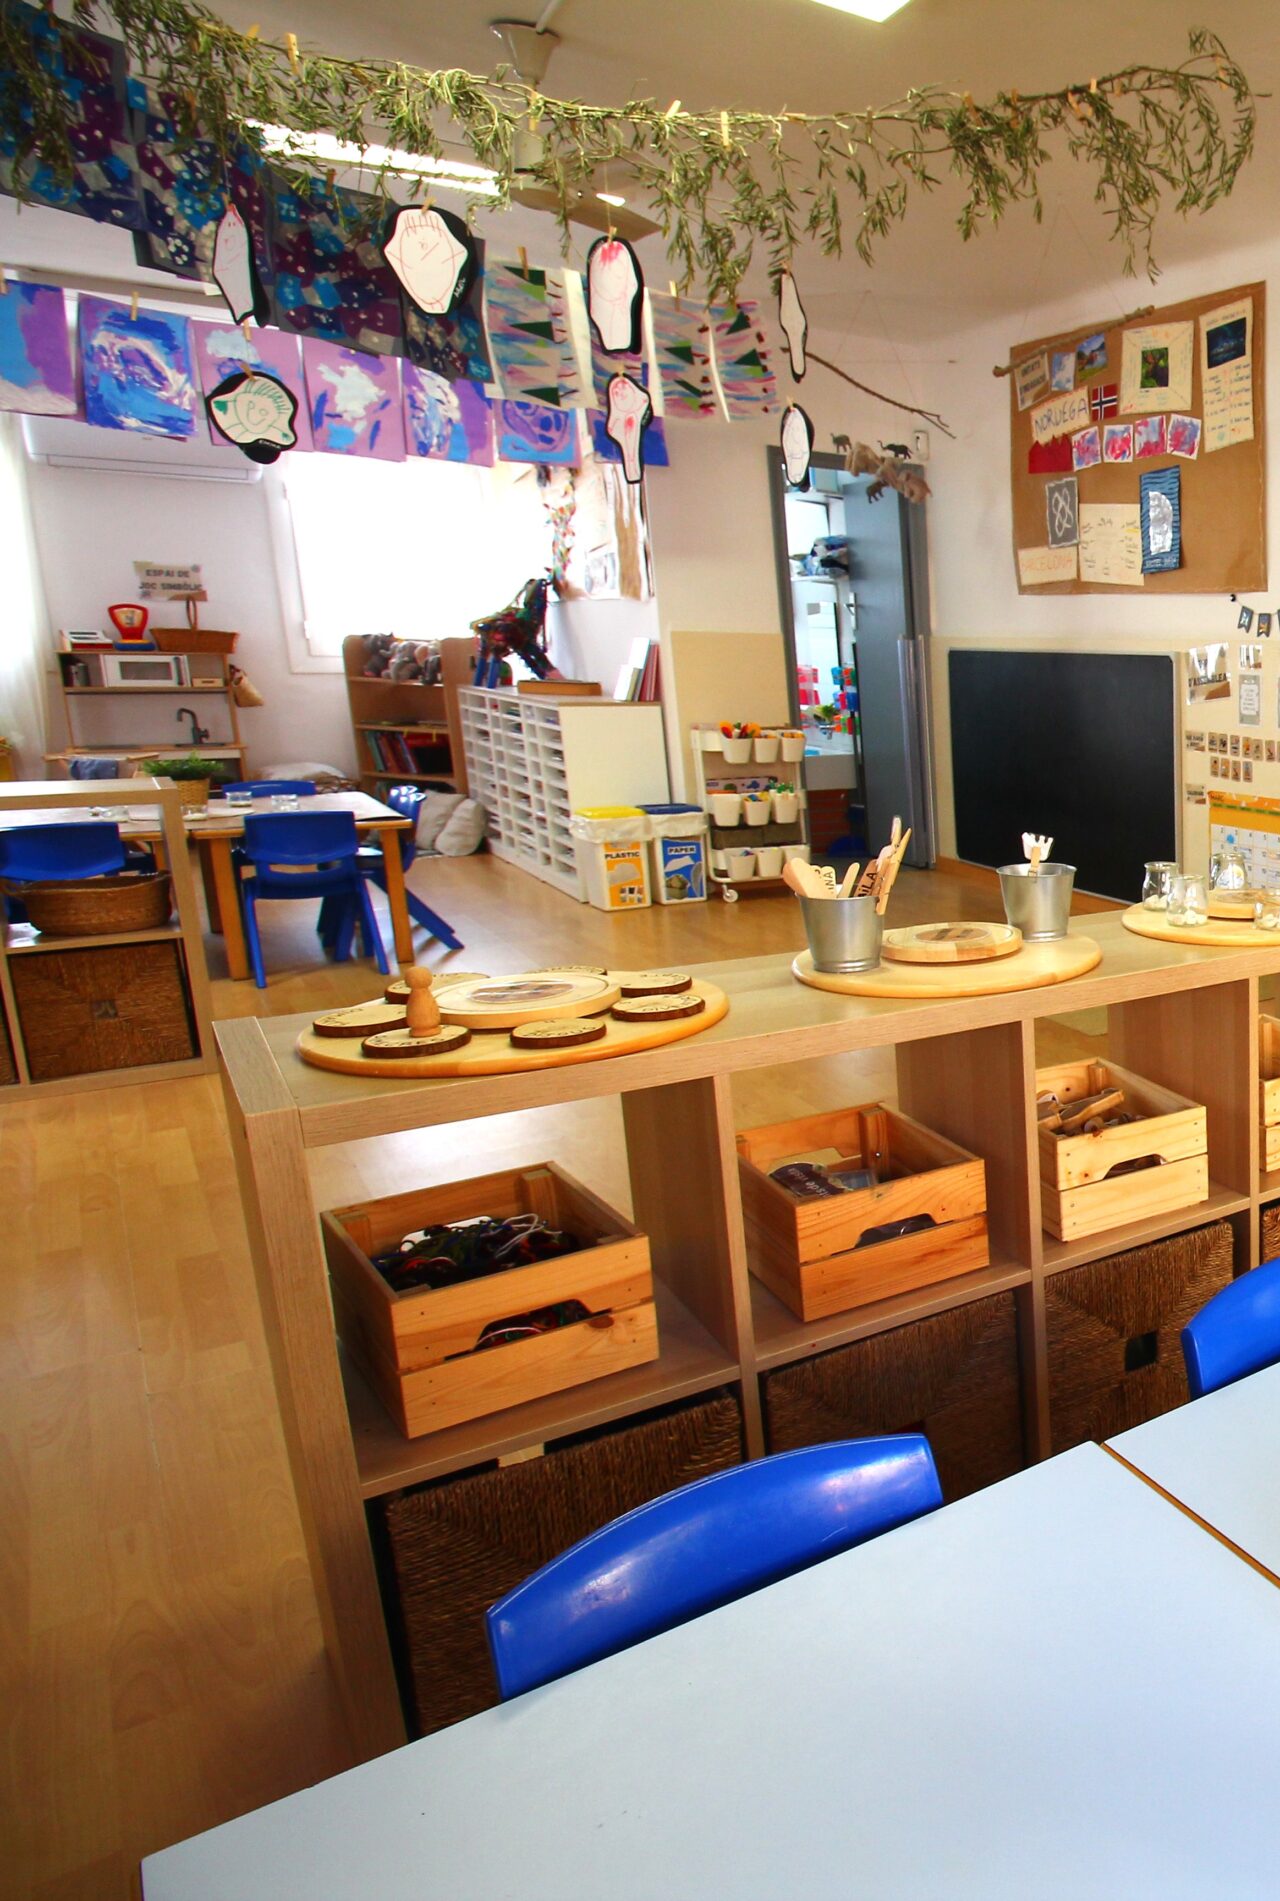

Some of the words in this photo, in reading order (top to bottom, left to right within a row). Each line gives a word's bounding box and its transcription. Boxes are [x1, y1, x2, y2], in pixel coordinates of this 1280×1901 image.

[145, 569, 175, 577] ESPAI
[177, 570, 190, 578] DE
[138, 582, 157, 590] JOC
[604, 851, 640, 859] PLASTIC
